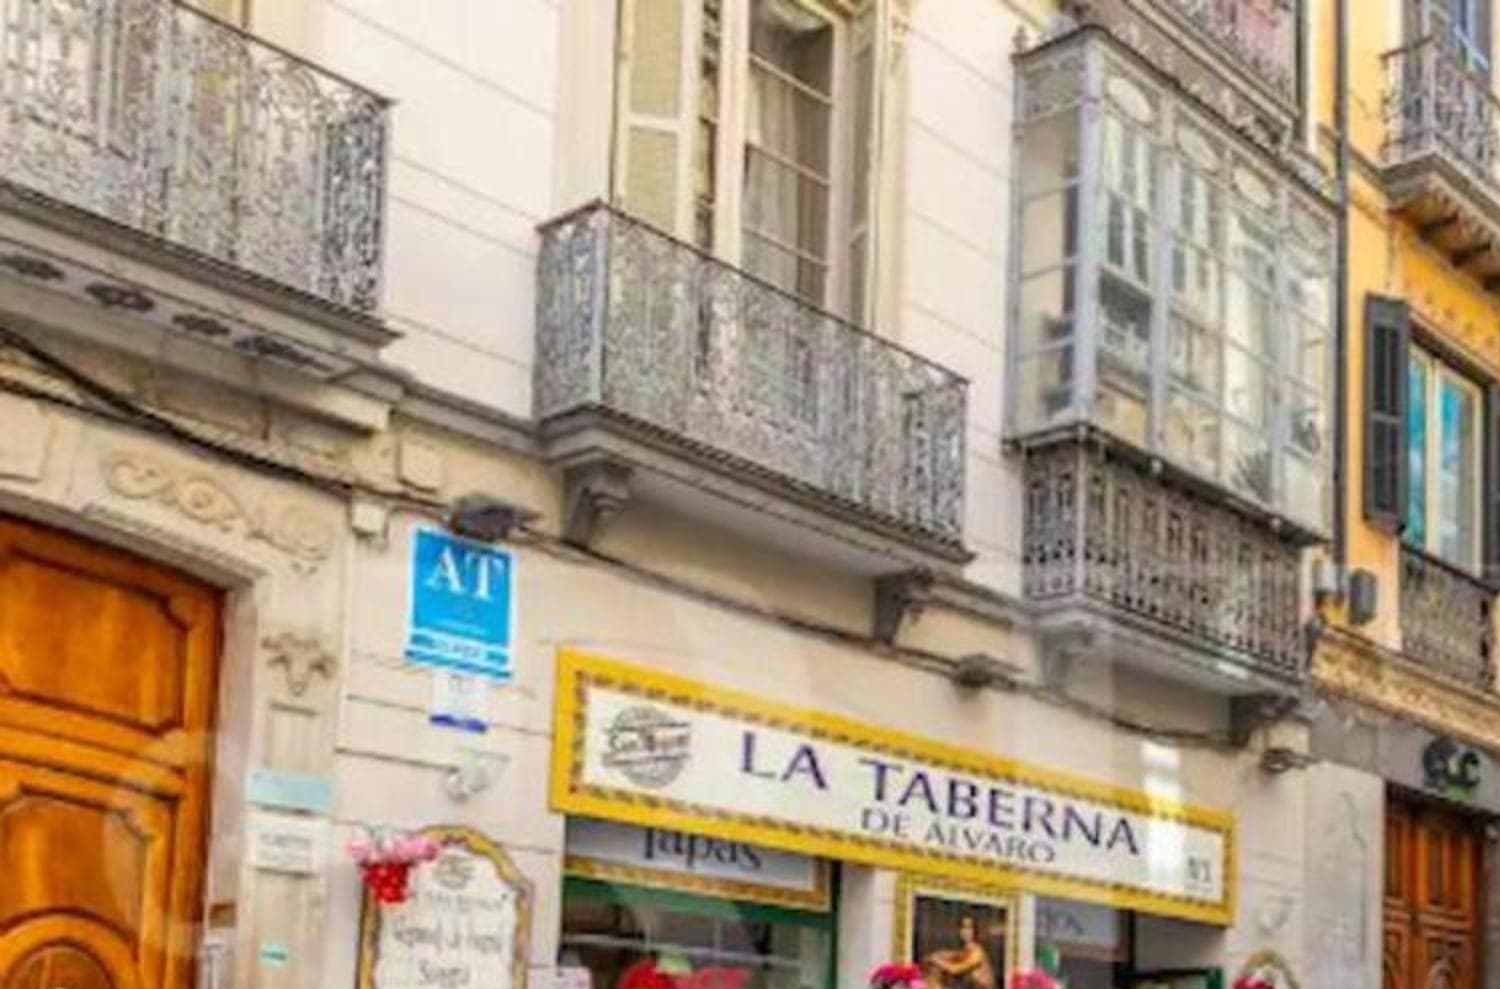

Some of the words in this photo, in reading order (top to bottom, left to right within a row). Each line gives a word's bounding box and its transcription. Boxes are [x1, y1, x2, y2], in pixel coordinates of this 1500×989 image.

[423, 546, 505, 600] AT
[742, 732, 828, 791] LA
[857, 757, 1140, 856] TABERNA
[862, 807, 908, 838] DE
